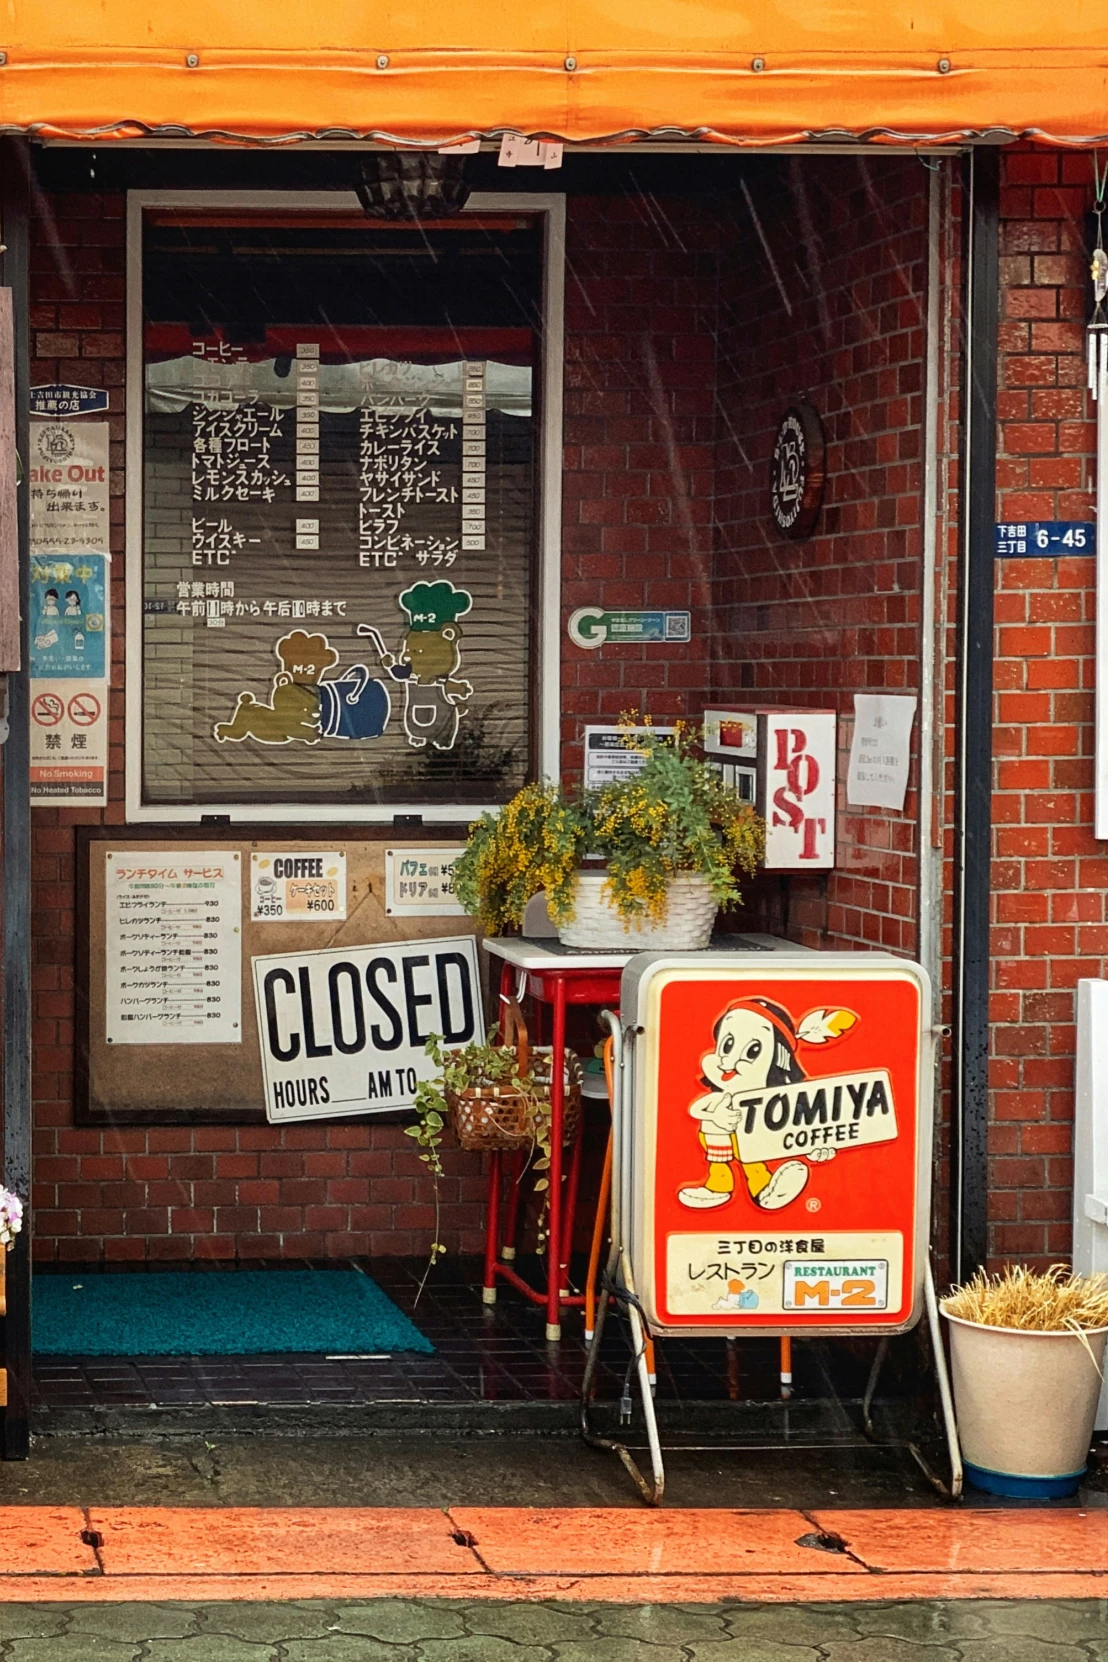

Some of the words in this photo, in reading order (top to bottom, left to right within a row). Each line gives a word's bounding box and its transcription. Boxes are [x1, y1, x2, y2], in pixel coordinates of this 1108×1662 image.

[192, 341, 244, 356] コーヒー
[35, 400, 80, 411] 推薦の店
[192, 421, 283, 437] アイスクリーム
[359, 423, 459, 440] チキンバスケット
[193, 437, 271, 453] 各種フロート
[359, 440, 441, 456] カレーライス
[192, 452, 271, 469] トマトジュース
[359, 456, 428, 471] ナポリタン
[67, 465, 105, 482] Out
[192, 470, 292, 486] レモンスカッシュ
[359, 471, 442, 487] ヤサイサンド
[192, 485, 276, 503] ミルクセーキ
[359, 487, 459, 503] フレンチトースト
[359, 502, 406, 519] トースト
[192, 517, 233, 533] ビール
[359, 520, 399, 535] ピラフ
[997, 525, 1027, 538] 下吉田
[192, 532, 261, 549] ウイスキー
[359, 534, 459, 551] コンビネーション
[1036, 529, 1087, 548] 6-45
[997, 541, 1027, 553] 三丁目
[415, 550, 459, 568] サラダ
[176, 581, 235, 598] 営業時間
[413, 612, 437, 624] M-2
[292, 663, 316, 676] M-2
[39, 770, 53, 779] No
[54, 769, 93, 780] Smoking
[30, 786, 42, 794] No
[43, 786, 69, 794] Heated
[71, 786, 102, 794] Tobacco
[773, 728, 827, 860] POST
[115, 868, 179, 880] ランチタイム
[183, 868, 225, 879] サービス
[273, 858, 324, 879] COFFEE
[399, 859, 428, 877] パフェ
[290, 882, 336, 898] ケーキセット
[399, 881, 428, 898] ドリア
[257, 904, 283, 916] ¥350
[306, 899, 335, 912] ¥600
[264, 952, 475, 1062] CLOSED
[273, 1076, 331, 1109] HOURS
[368, 1070, 393, 1099] AM
[396, 1067, 418, 1096] TO
[739, 1080, 890, 1134] TOMIYA
[783, 1122, 860, 1150] COFFEE
[717, 1239, 826, 1254] 三丁目の洋食屋
[688, 1262, 776, 1280] レストラン
[794, 1265, 877, 1278] RESTAURANT
[794, 1279, 877, 1307] M-2
